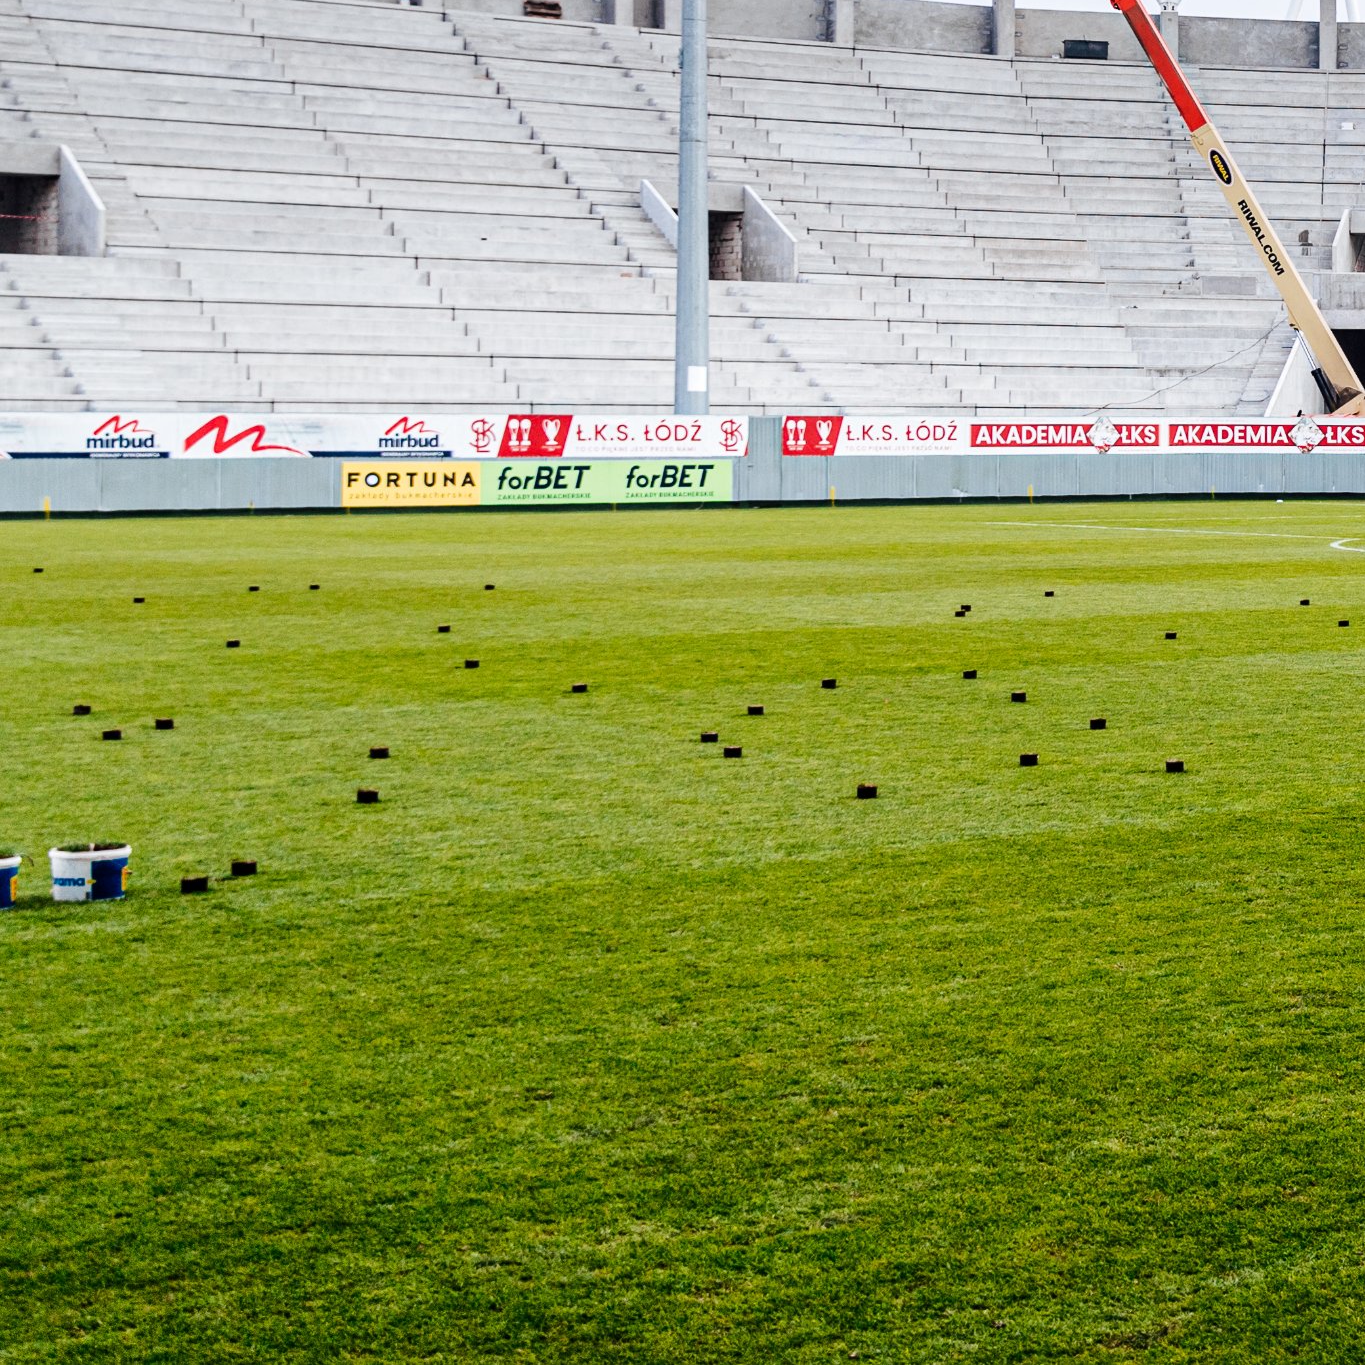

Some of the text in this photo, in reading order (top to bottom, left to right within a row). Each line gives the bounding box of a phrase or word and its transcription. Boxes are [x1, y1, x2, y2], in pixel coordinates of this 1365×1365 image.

[1212, 154, 1229, 182] RIWAL
[1238, 199, 1285, 276] RIWAL.COM
[86, 433, 155, 449] mirbud
[378, 433, 439, 448] mirbud
[576, 419, 702, 442] Ł.K.S. ŁÓDŹ
[846, 419, 958, 441] Ł.K.S. ŁÓDŹ
[975, 425, 1156, 445] AKADEMIA ŁKS
[1173, 425, 1365, 444] AKADEMIA ŁKS
[347, 472, 476, 488] FORTUNA
[498, 465, 591, 490] forBET
[626, 464, 714, 489] forBET
